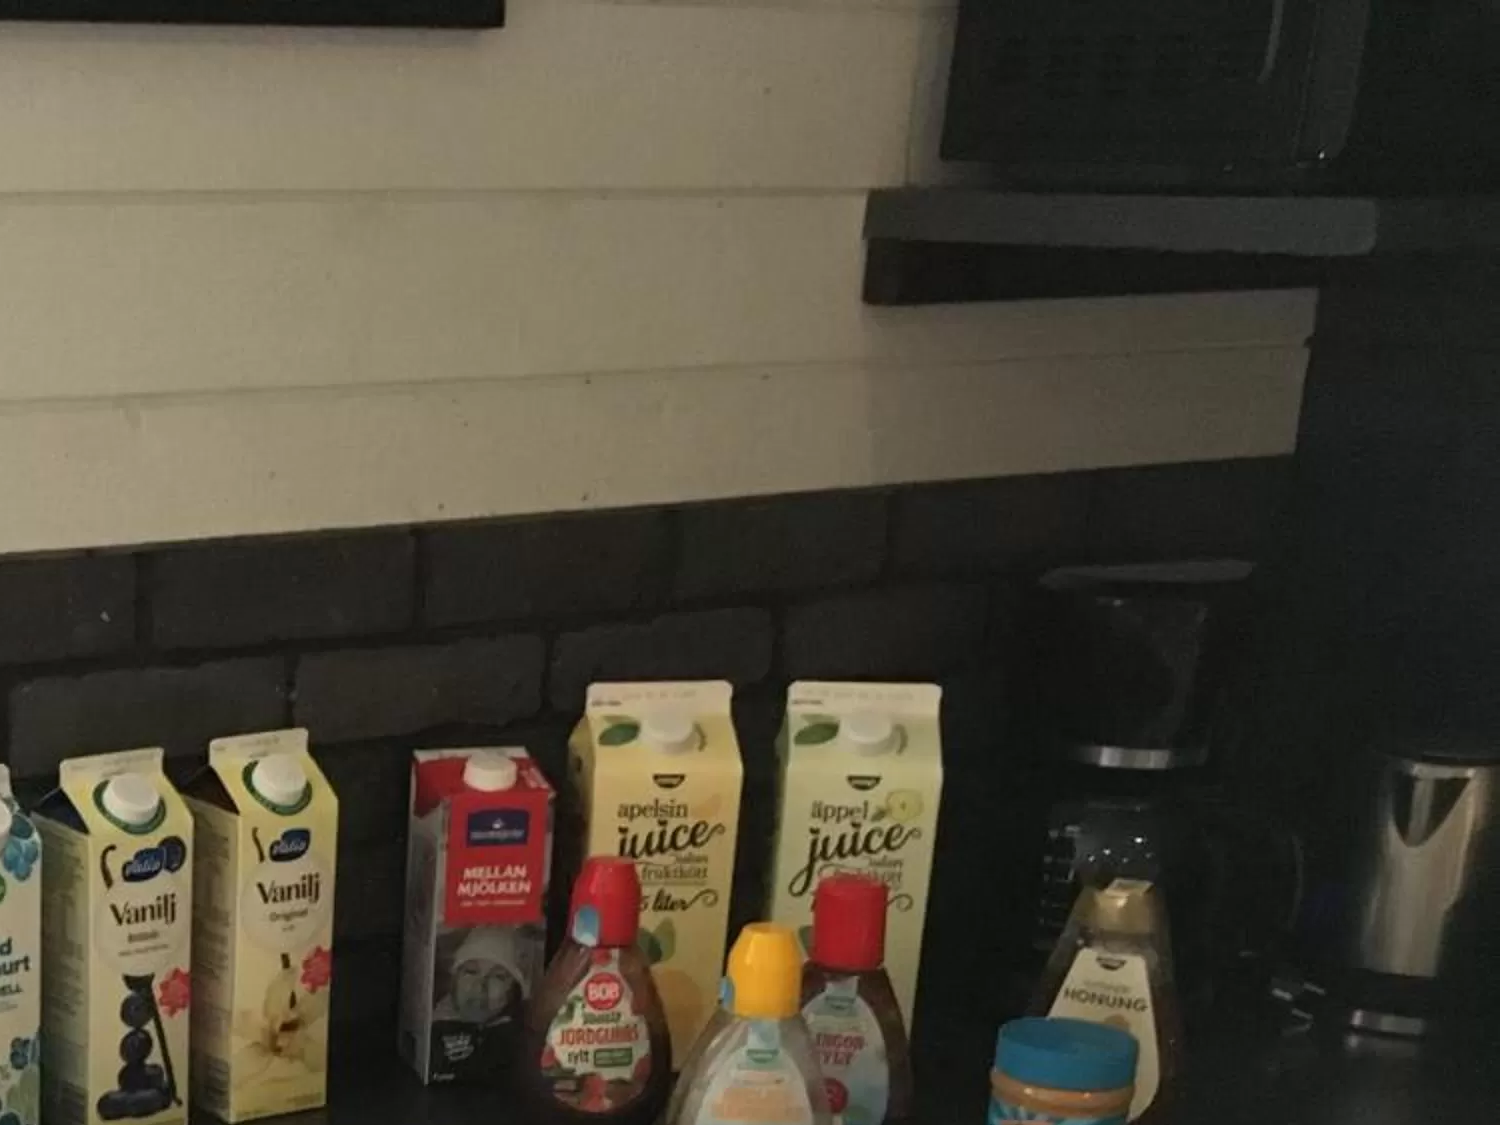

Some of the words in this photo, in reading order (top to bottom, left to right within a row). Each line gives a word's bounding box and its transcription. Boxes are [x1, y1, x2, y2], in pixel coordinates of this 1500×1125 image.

[617, 798, 688, 822] apelsin
[811, 799, 869, 824] äppel
[617, 819, 726, 859] juice
[463, 864, 528, 880] MELLAN
[788, 822, 923, 898] juice
[257, 871, 320, 905] Vanilj
[456, 878, 532, 898] MJÖLKEN
[109, 892, 177, 926] Vanilj
[586, 981, 620, 1002] BOB
[1063, 987, 1149, 1013] HONUNG
